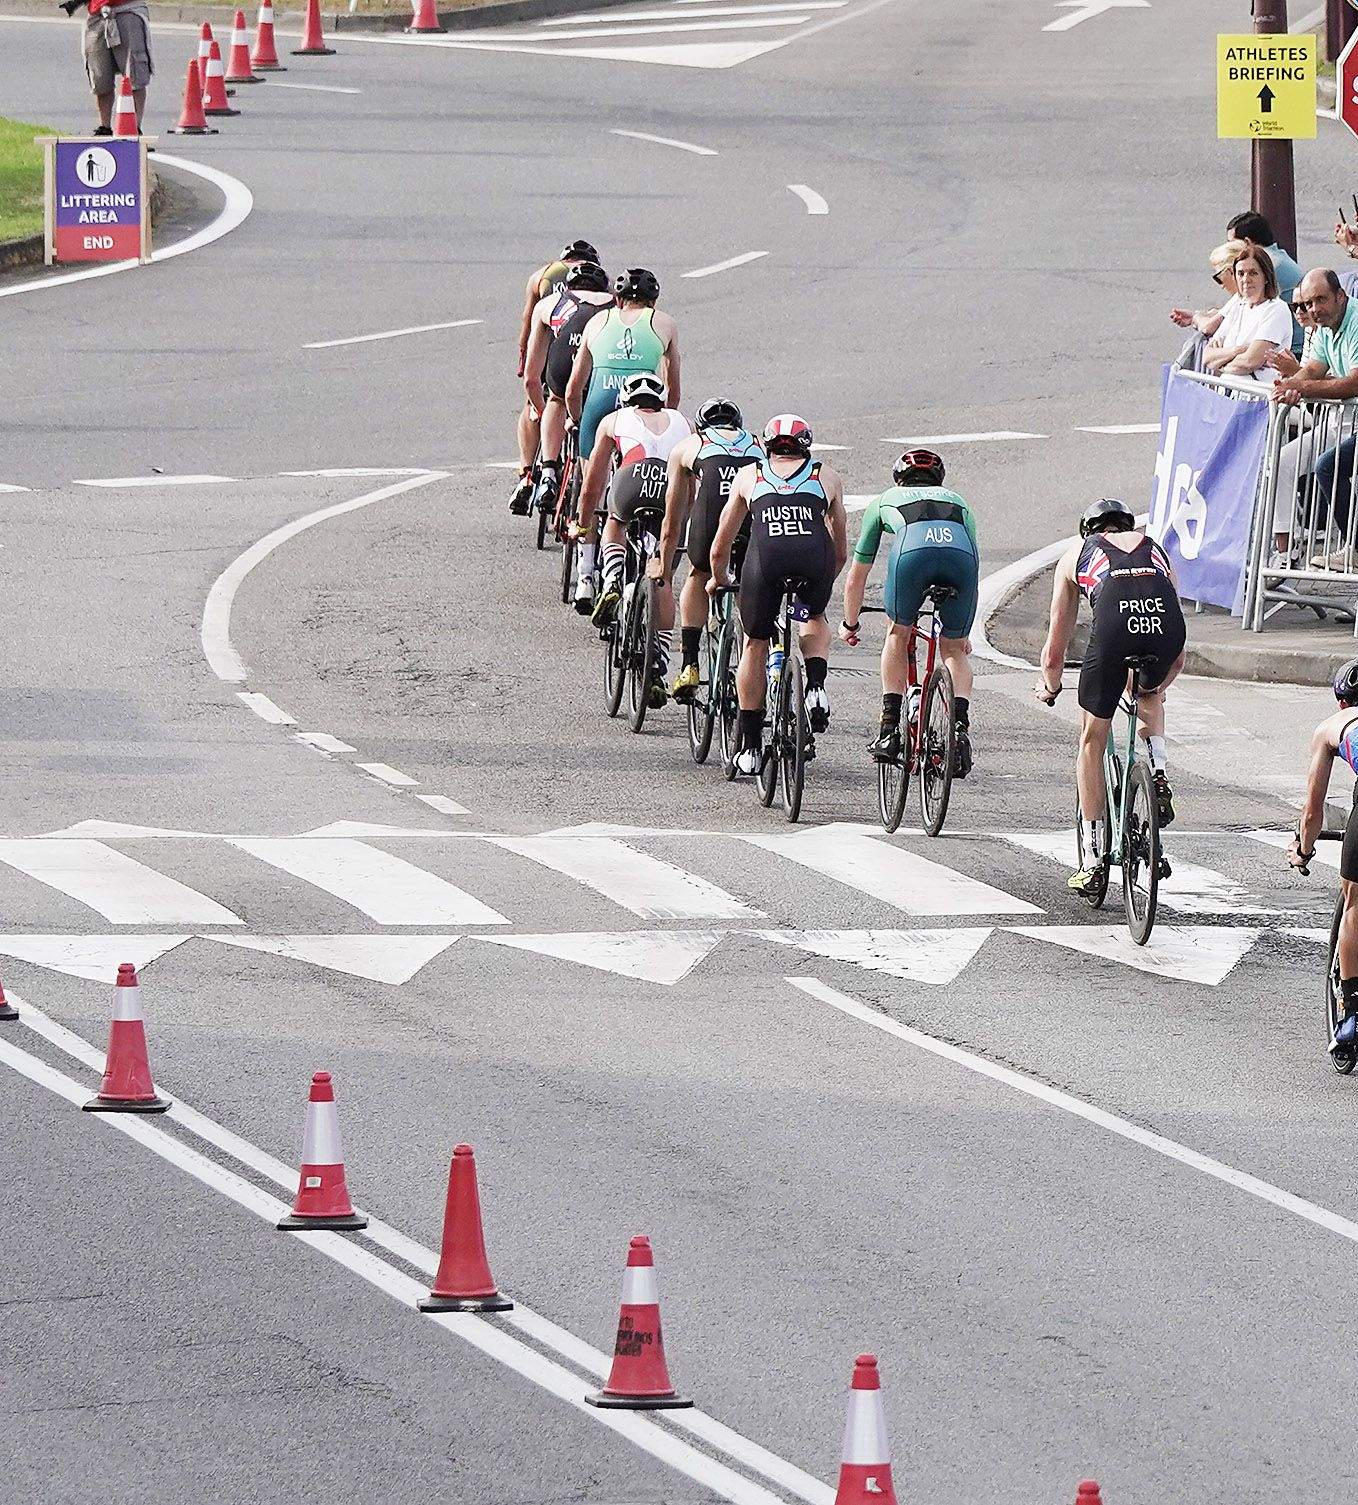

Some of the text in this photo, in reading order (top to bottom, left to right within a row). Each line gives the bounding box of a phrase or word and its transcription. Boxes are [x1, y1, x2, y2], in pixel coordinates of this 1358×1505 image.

[1226, 48, 1308, 61] ATHLETES
[1229, 68, 1305, 80] BRIEFING
[61, 192, 136, 208] LITTERING
[79, 209, 119, 224] AREA
[83, 236, 114, 250] END
[632, 463, 668, 481] FUCH
[639, 480, 666, 500] AUT
[761, 506, 813, 522] HUSTIN
[768, 521, 813, 537] BEL
[924, 527, 954, 544] AUS
[1119, 597, 1166, 614] PRICE
[1127, 616, 1164, 635] GBR
